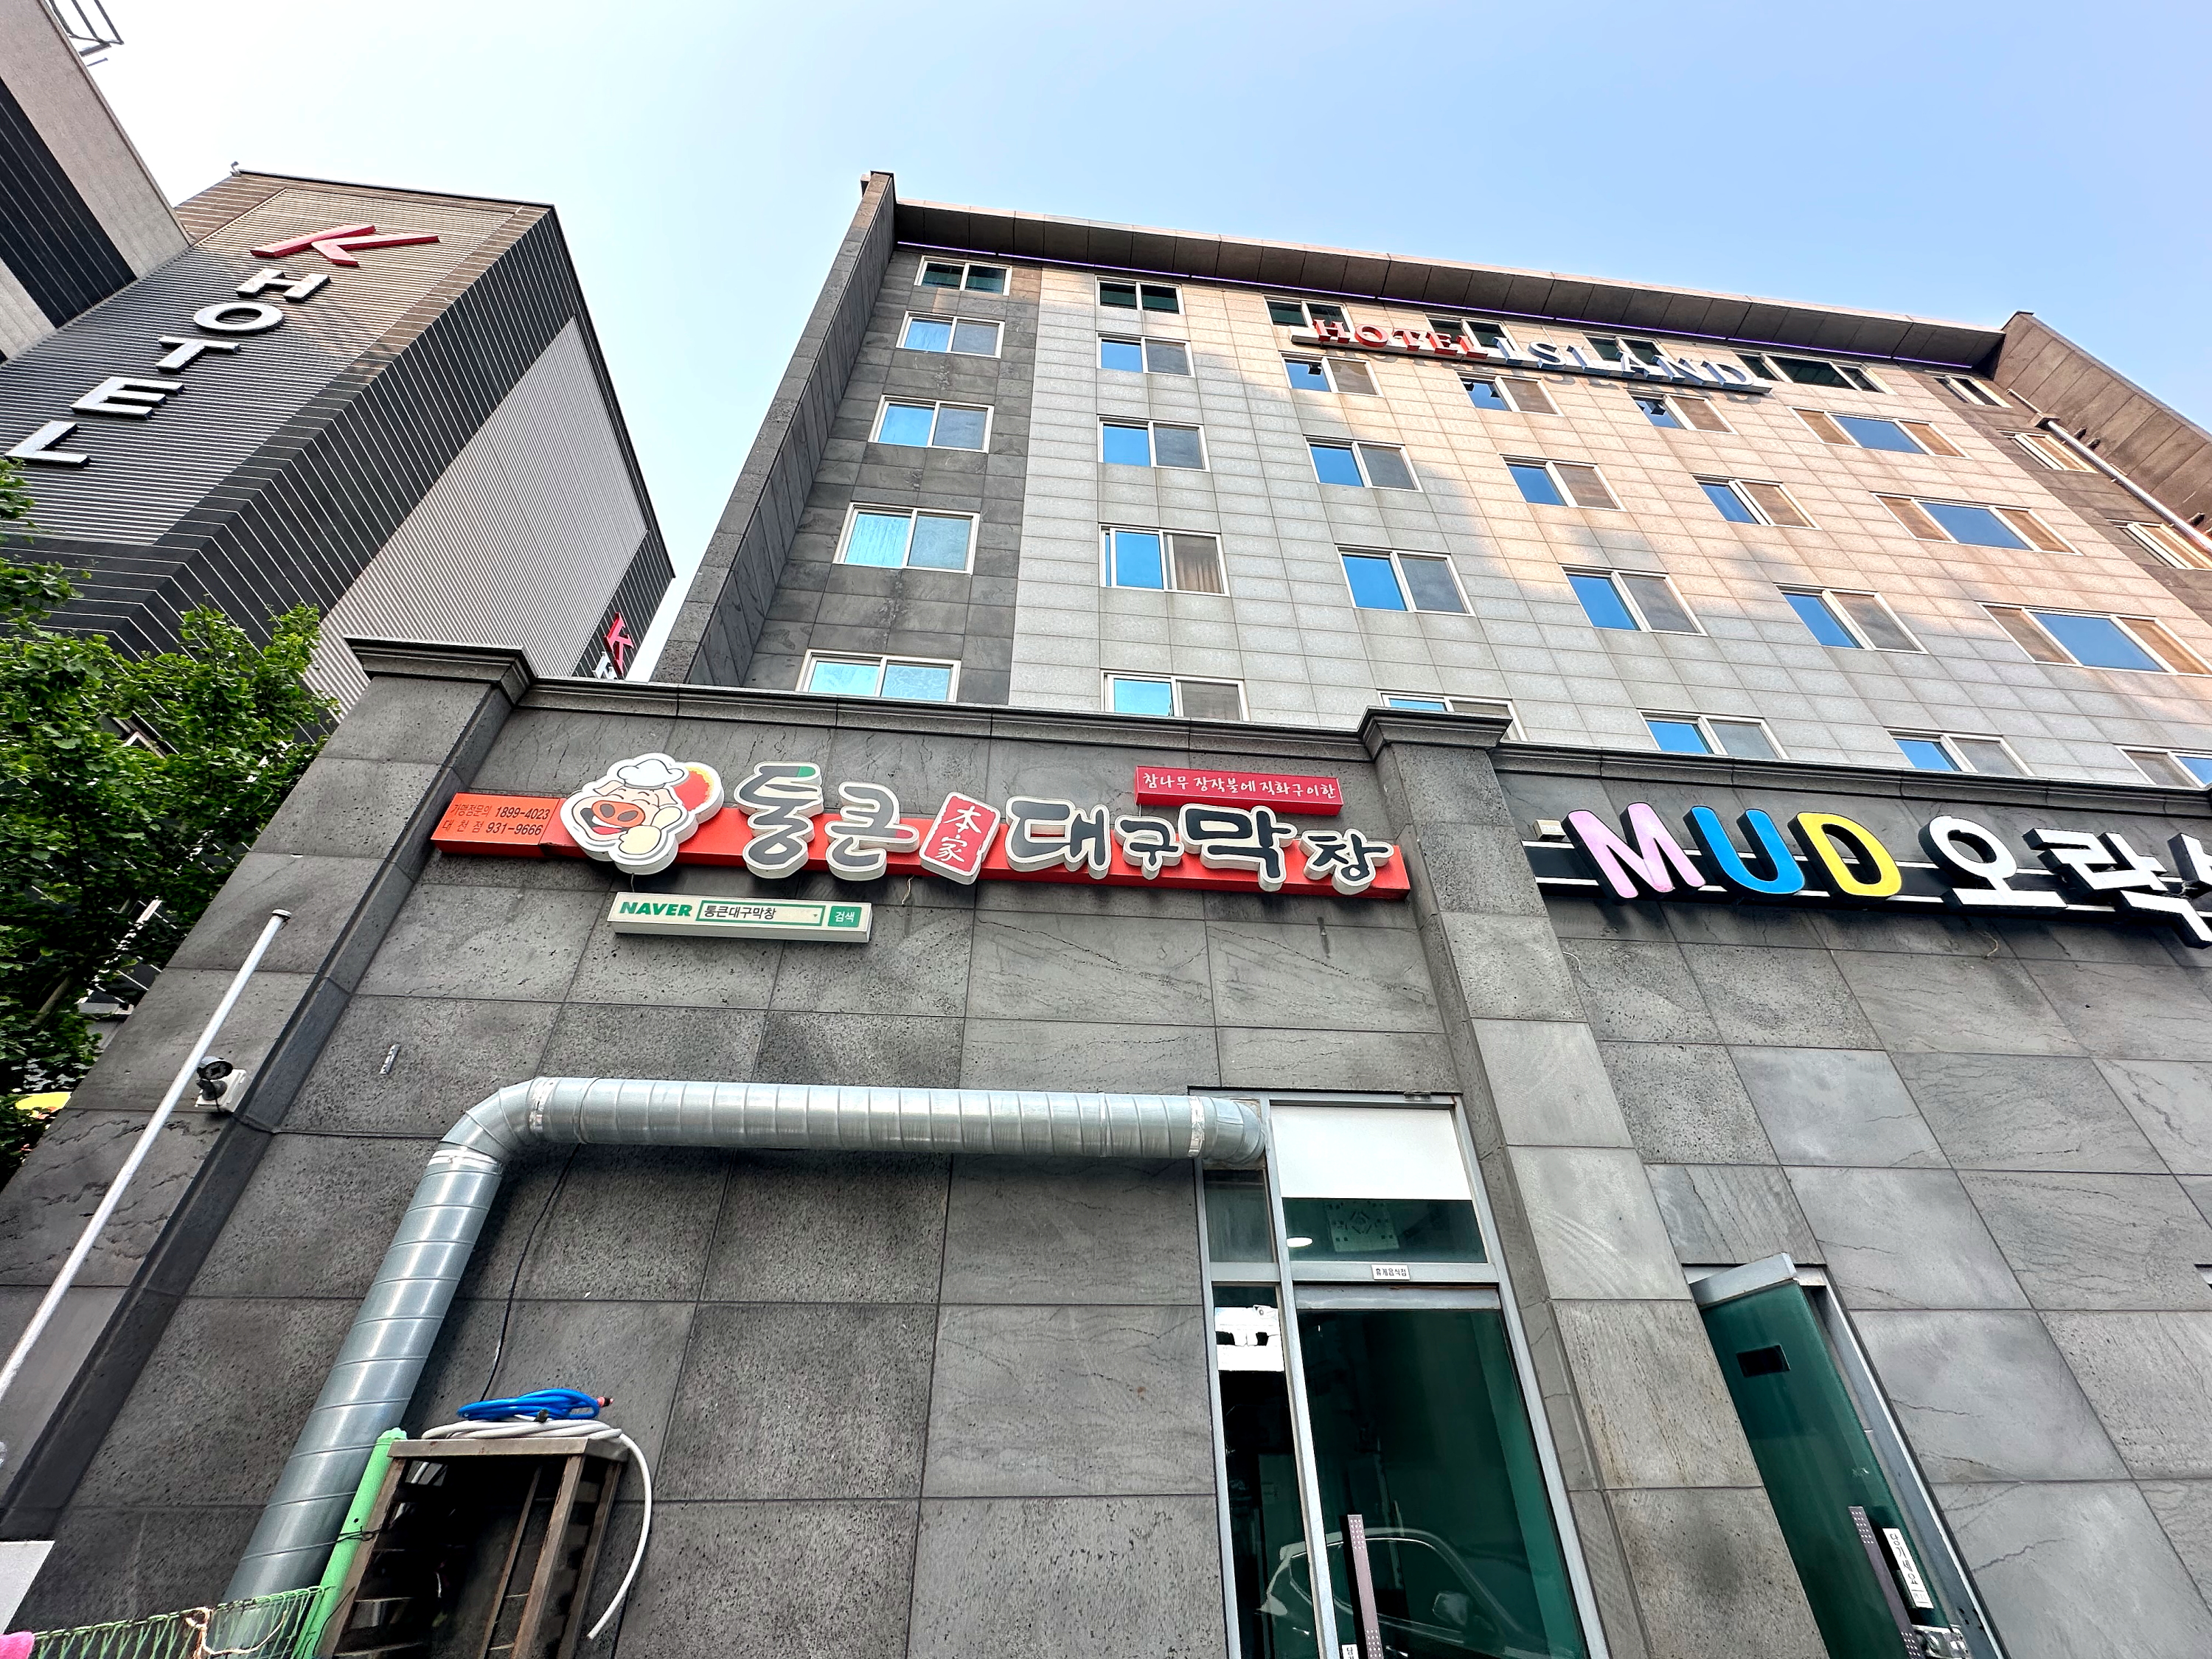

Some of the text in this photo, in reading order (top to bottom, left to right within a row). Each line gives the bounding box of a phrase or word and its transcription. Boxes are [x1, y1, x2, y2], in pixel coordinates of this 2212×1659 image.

[5, 224, 439, 467] K HOTEL
[1312, 319, 1754, 387] HOTEL ISLAND
[450, 803, 550, 820] 가맹점문의 1899-4023
[1143, 773, 1336, 799] 참나무 장작불에 직화구이한
[485, 822, 543, 835] 931-9666
[736, 763, 1392, 888] 통큰 本家 대구막창
[1562, 801, 1902, 900] MUD
[619, 901, 856, 924] NAVER 통큰대구막창 검색
[1889, 1532, 1919, 1585] 당기세요
